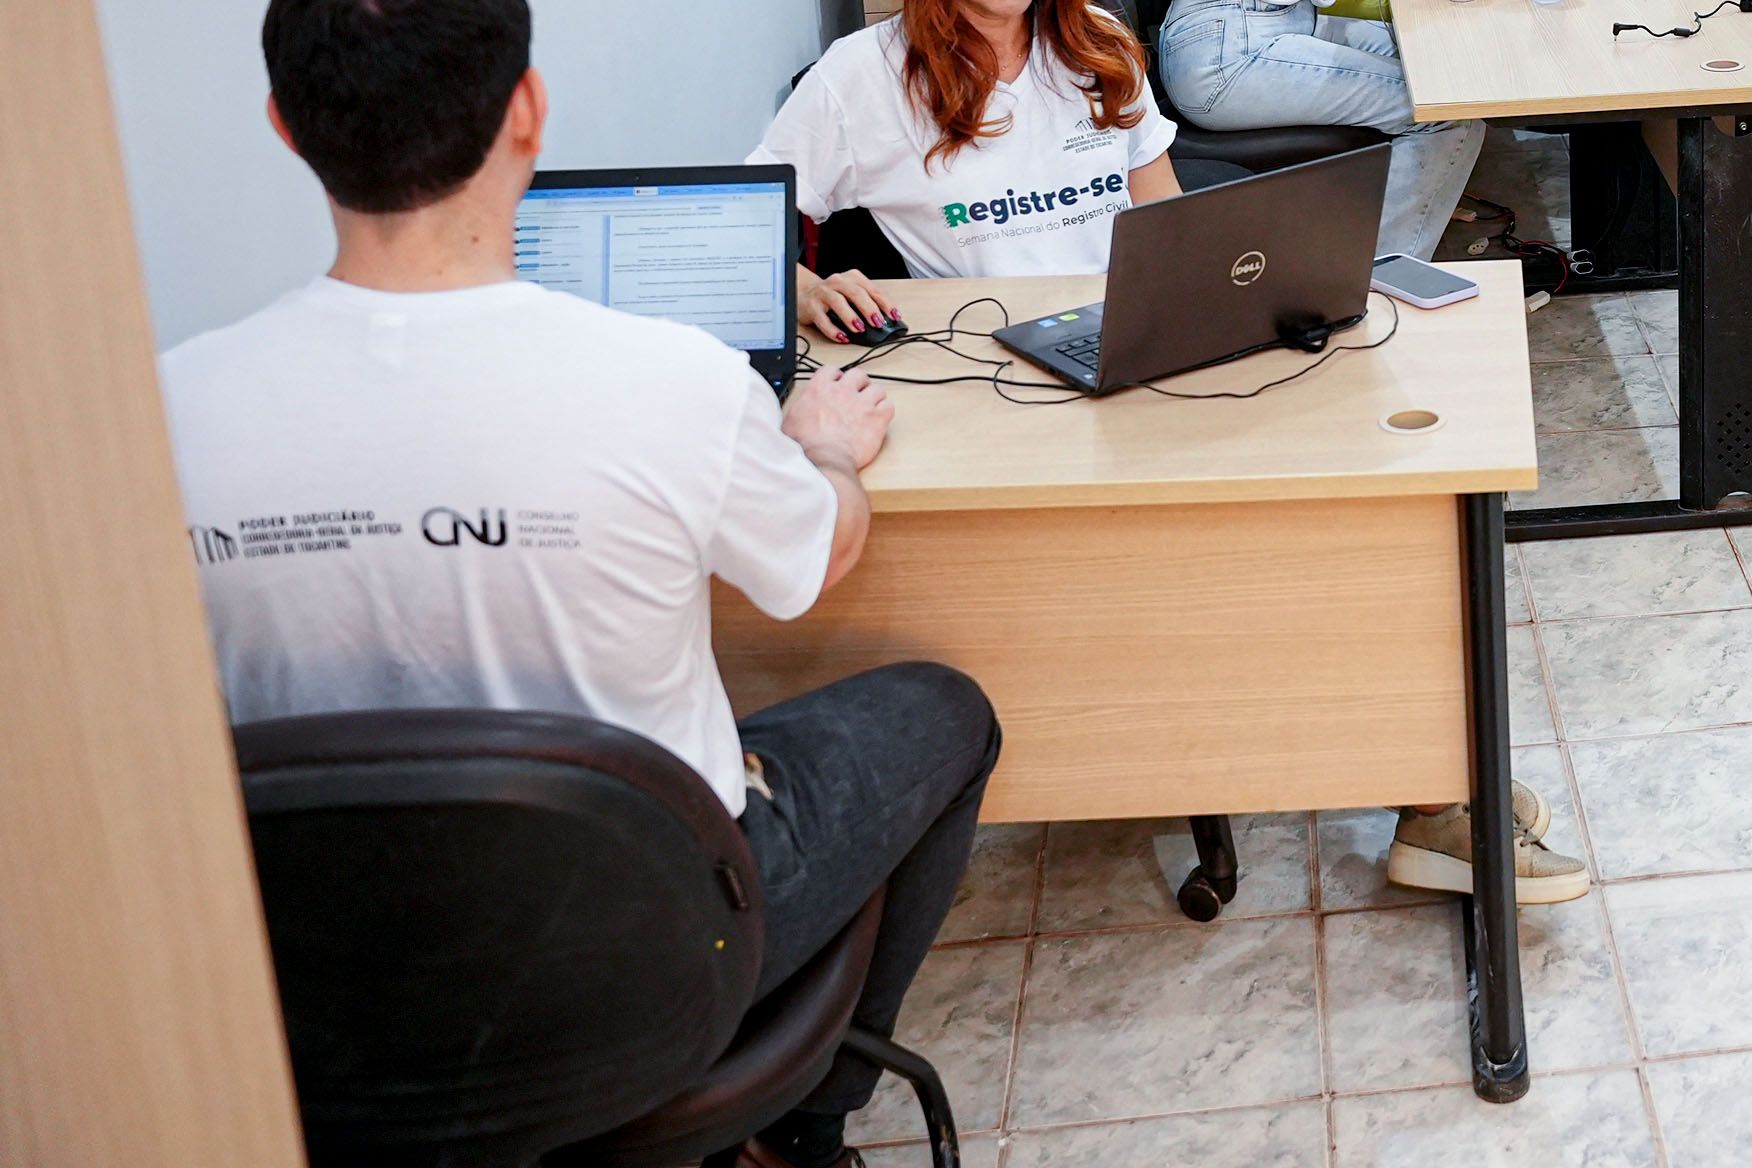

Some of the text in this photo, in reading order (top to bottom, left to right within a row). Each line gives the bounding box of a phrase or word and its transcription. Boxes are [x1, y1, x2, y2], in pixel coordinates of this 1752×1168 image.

[957, 199, 1129, 248] Semana Nacional do Registro Civil
